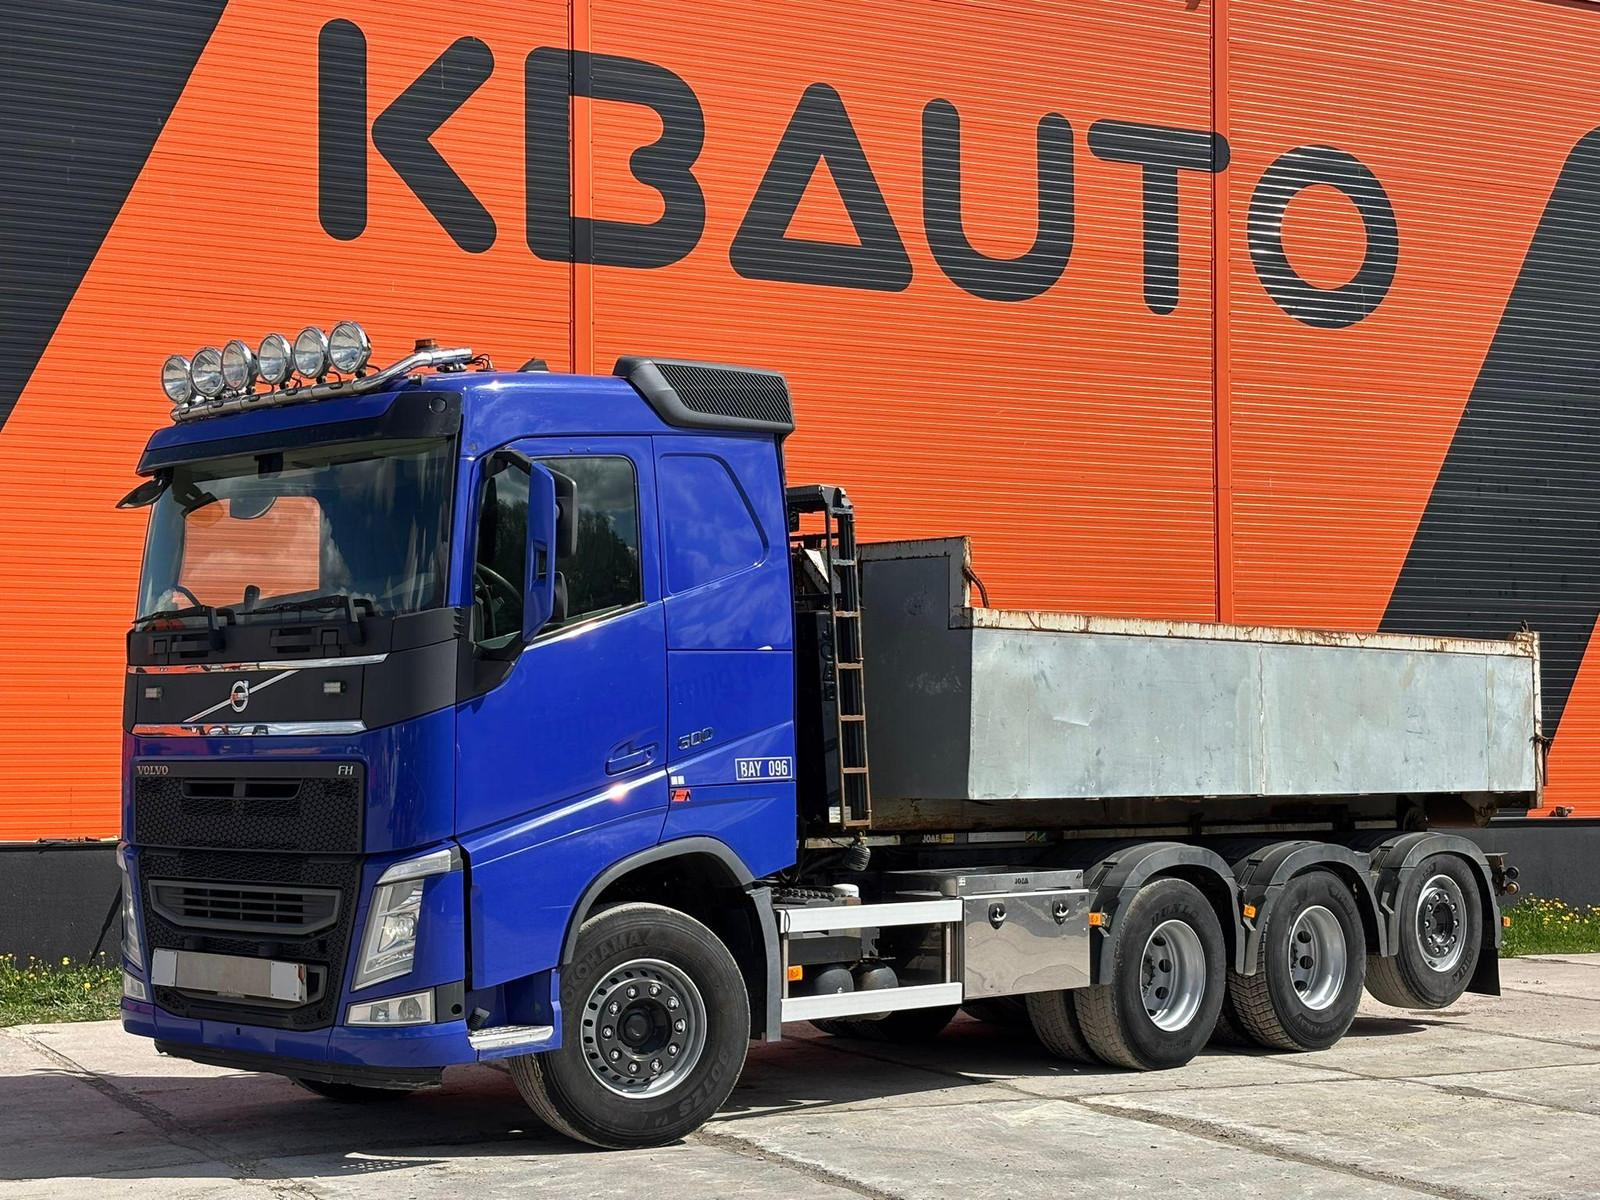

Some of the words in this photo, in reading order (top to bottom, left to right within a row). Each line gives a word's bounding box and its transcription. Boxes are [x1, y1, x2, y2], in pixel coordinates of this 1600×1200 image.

[678, 726, 713, 750] 500
[136, 765, 169, 775] VOLVO
[337, 765, 354, 775] FH
[740, 760, 762, 777] BAY
[768, 760, 788, 776] 096
